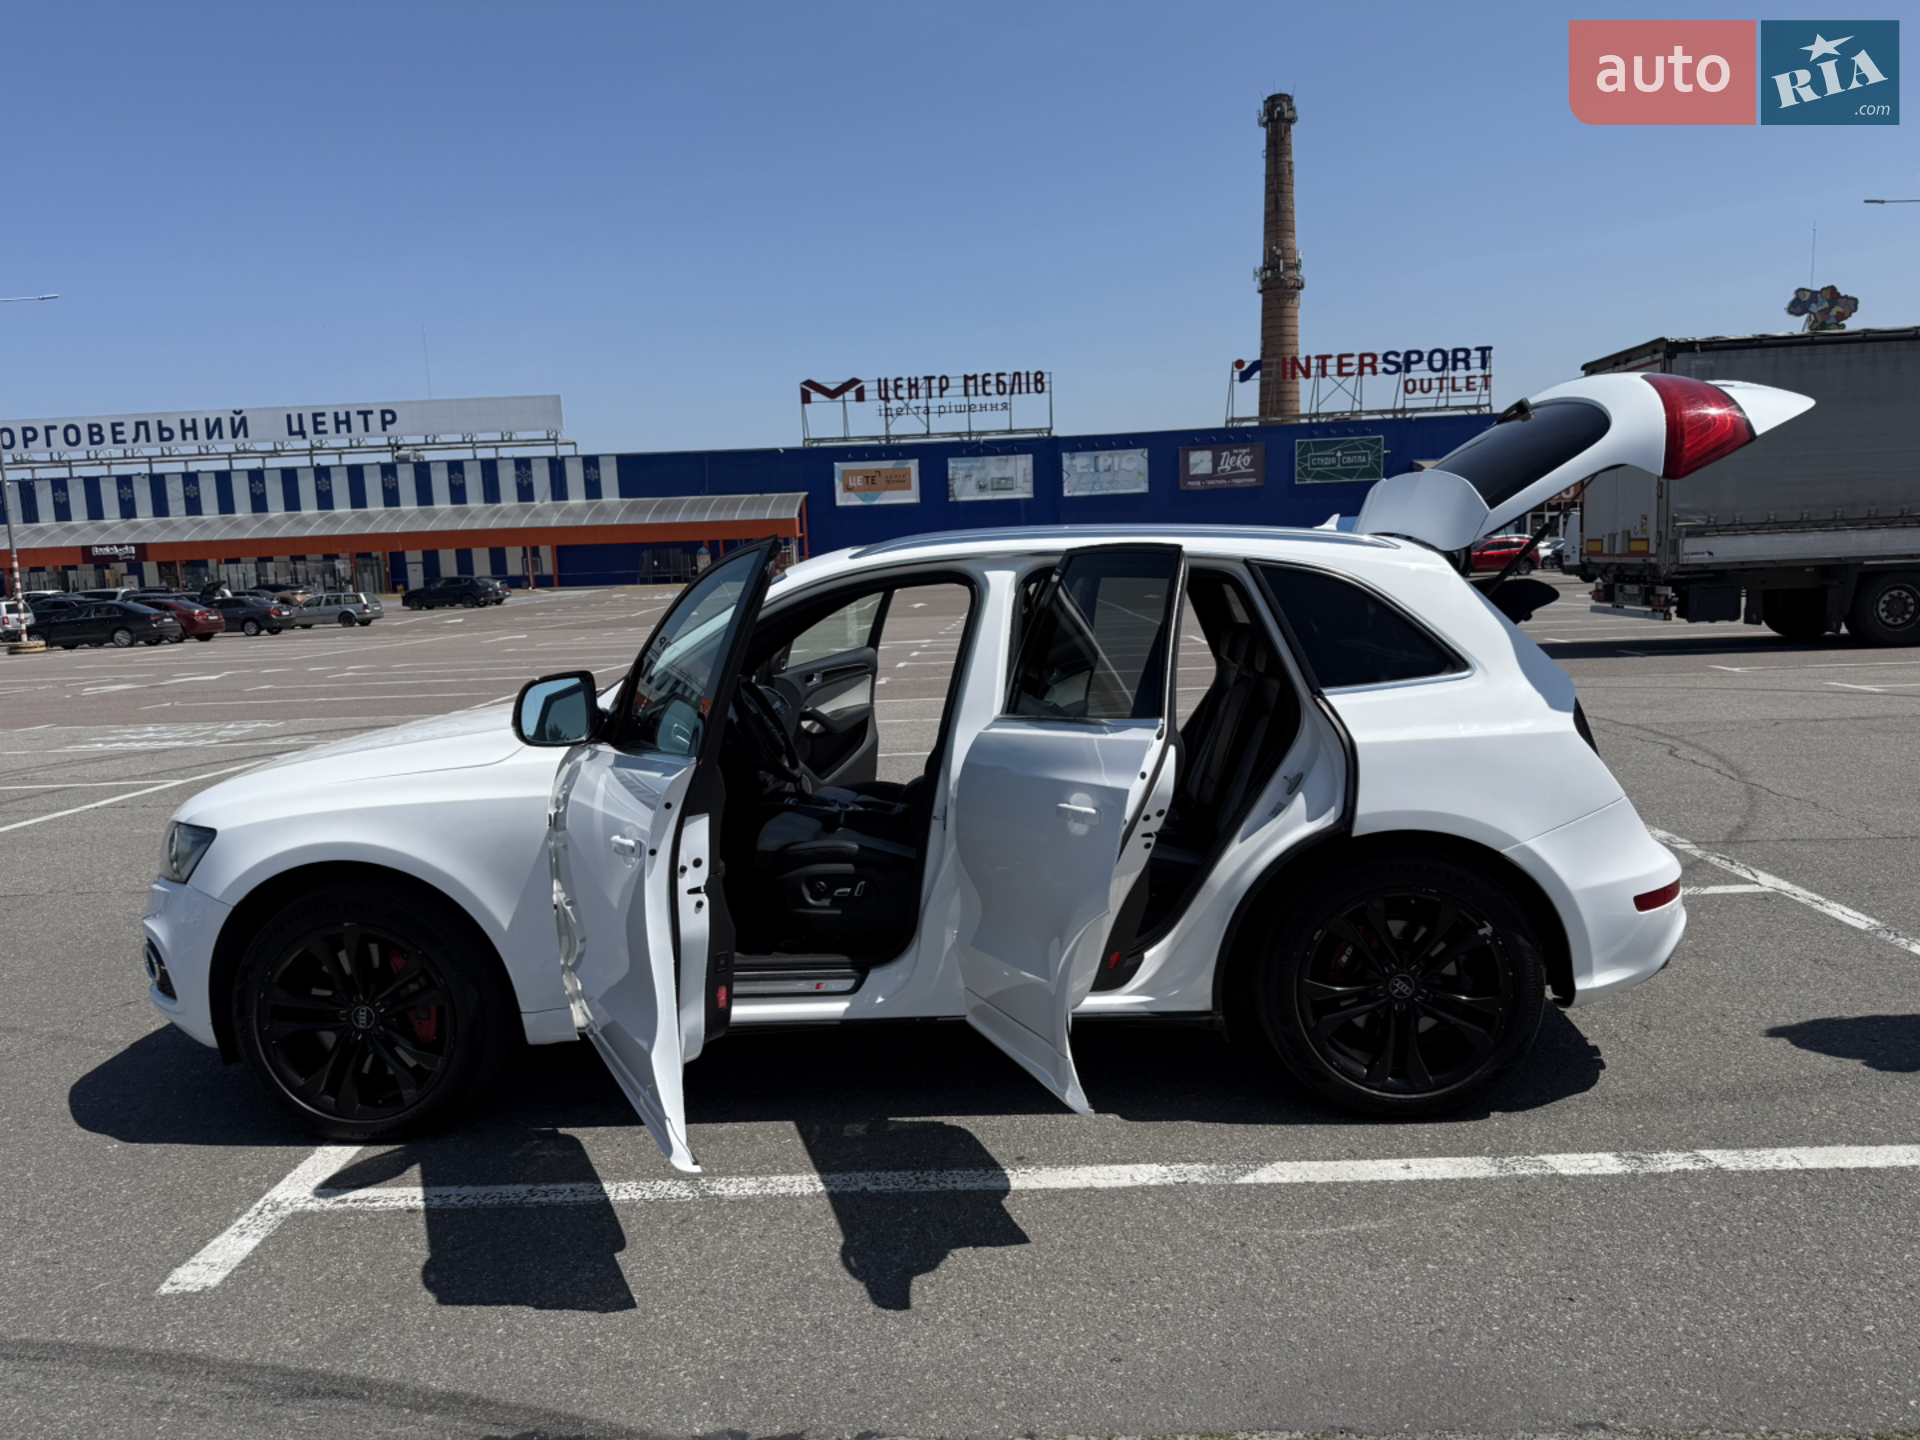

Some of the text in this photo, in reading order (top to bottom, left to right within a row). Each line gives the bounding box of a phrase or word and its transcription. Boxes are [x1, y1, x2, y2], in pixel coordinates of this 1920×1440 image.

[1280, 345, 1493, 381] INTERSPORT
[877, 370, 1045, 402] ЦЕНТР МЕБЛІВ
[1404, 374, 1493, 395] OUTLET
[914, 404, 931, 416] та
[938, 401, 1010, 418] рішення
[0, 408, 399, 451] ОРГОВЕЛЬНИЙ ЦЕНТР
[1311, 455, 1367, 466] СТУДІЯ СВІТЛА
